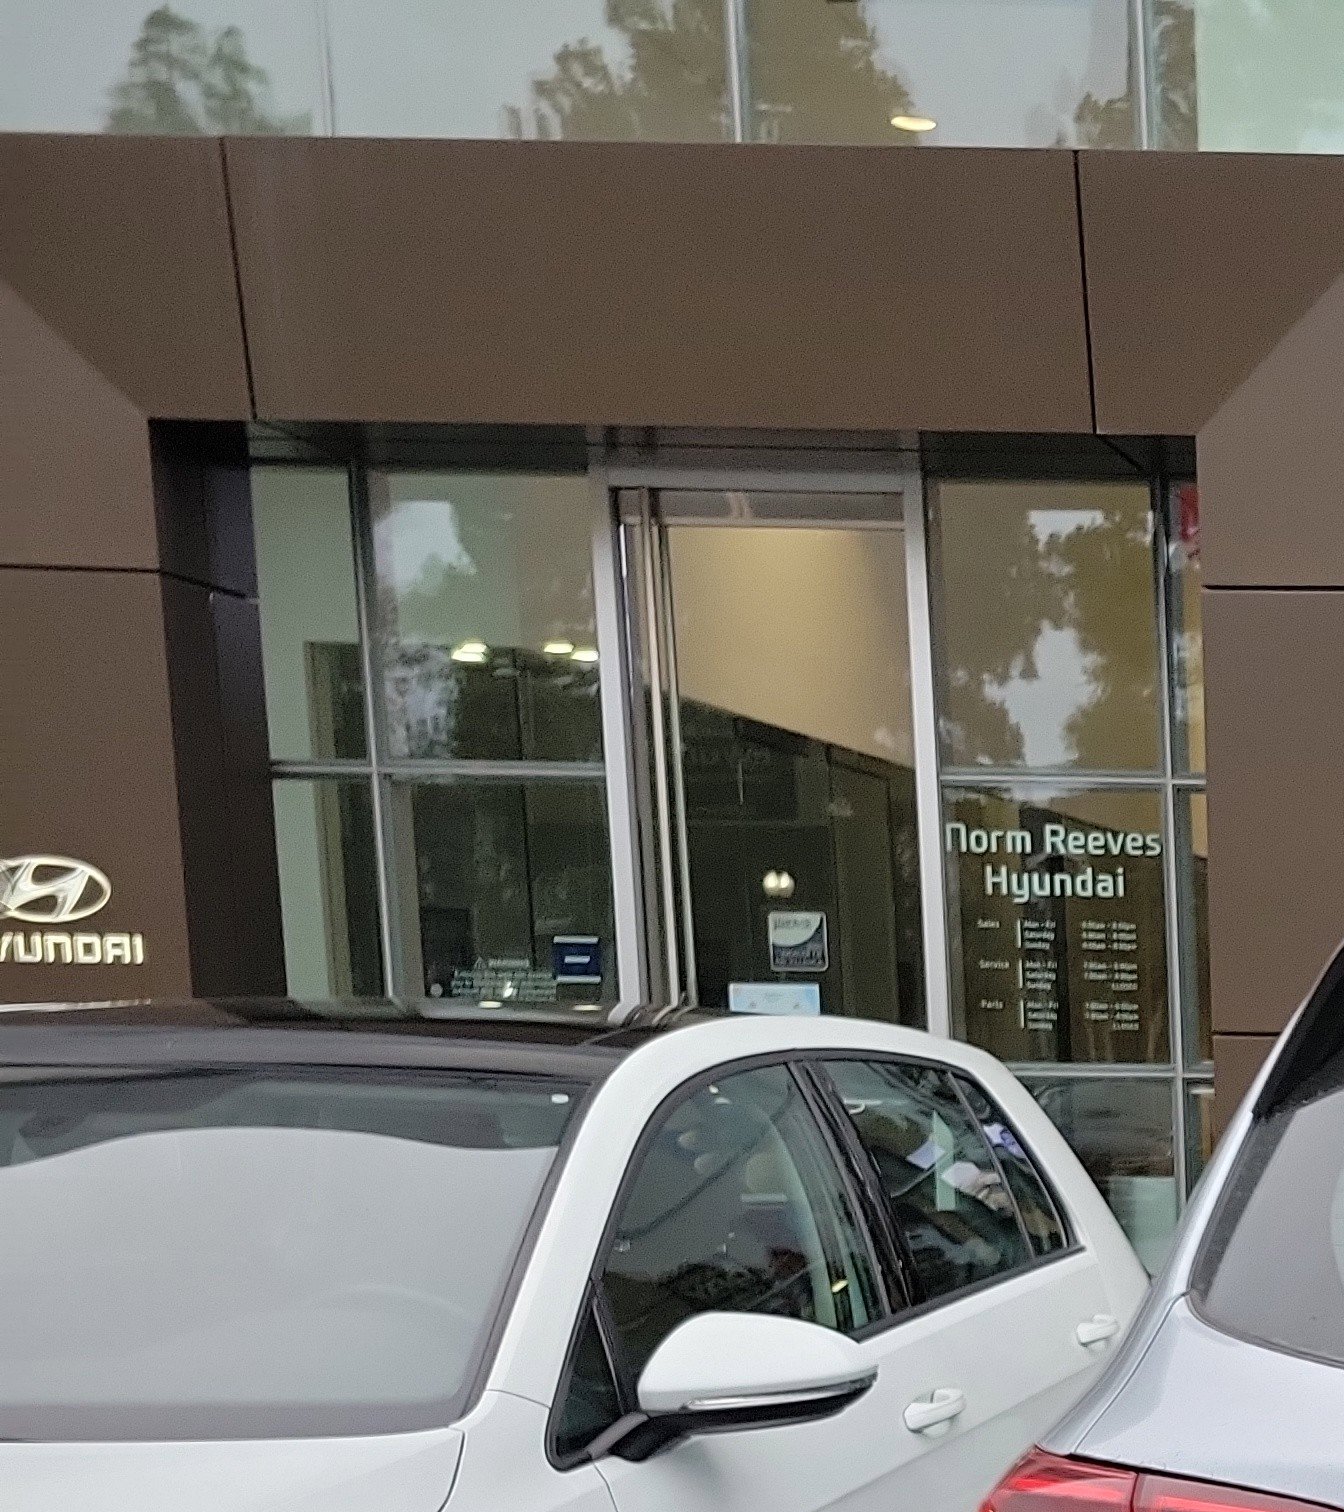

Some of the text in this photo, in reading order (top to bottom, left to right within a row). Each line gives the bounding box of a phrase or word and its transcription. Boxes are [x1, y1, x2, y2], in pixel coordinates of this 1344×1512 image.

[945, 821, 1163, 857] Norm Reeves
[984, 863, 1125, 905] Hyundai
[0, 931, 144, 965] YUNDAI
